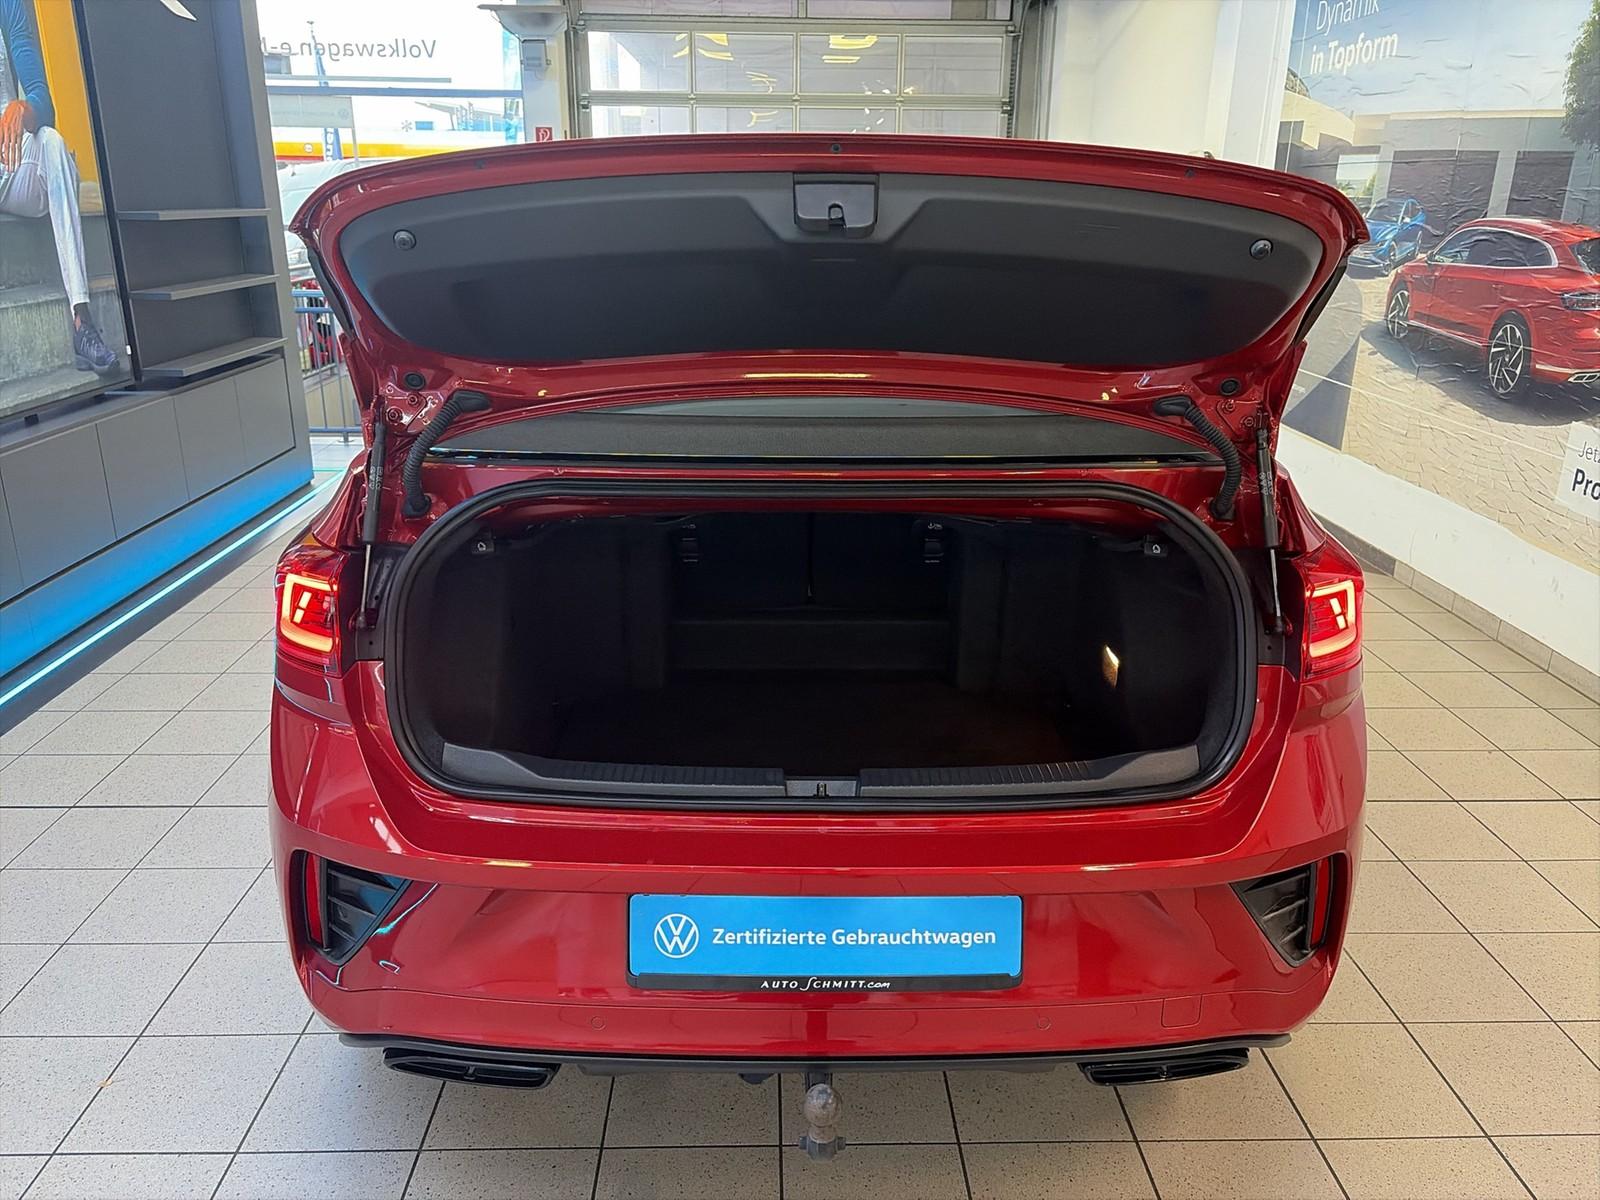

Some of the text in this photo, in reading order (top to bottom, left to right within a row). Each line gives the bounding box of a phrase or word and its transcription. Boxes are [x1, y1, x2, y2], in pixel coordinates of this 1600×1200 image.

[1310, 32, 1399, 76] in Topform
[1578, 441, 1600, 463] Jet
[712, 928, 997, 948] Zertifizierte Gebrauchtwagen
[760, 980, 799, 989] AUTO
